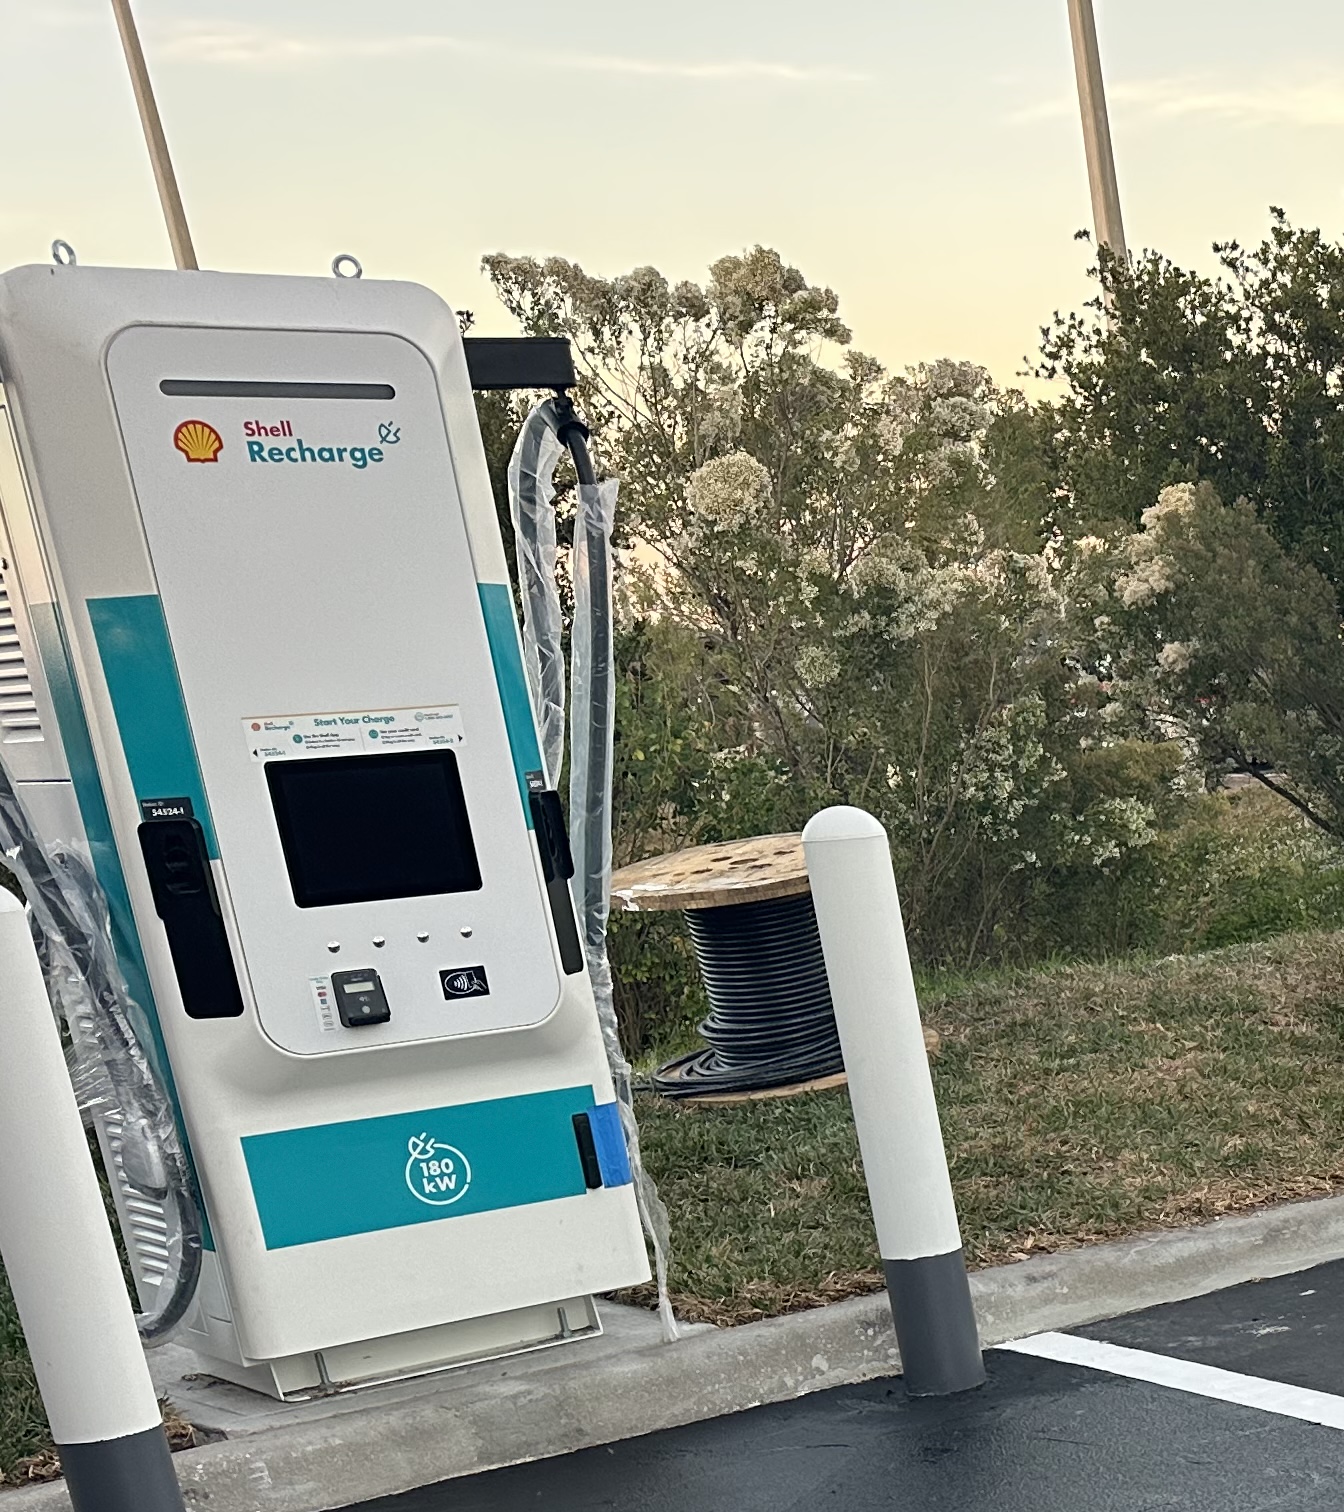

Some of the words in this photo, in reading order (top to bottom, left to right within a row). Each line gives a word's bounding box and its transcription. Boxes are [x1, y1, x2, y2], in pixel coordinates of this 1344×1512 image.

[243, 420, 293, 438] Shell
[246, 438, 384, 469] Recharge
[313, 718, 337, 727] Start
[338, 716, 360, 725] Your
[362, 714, 395, 725] Charge
[419, 1158, 454, 1177] 180
[422, 1174, 457, 1194] kW
